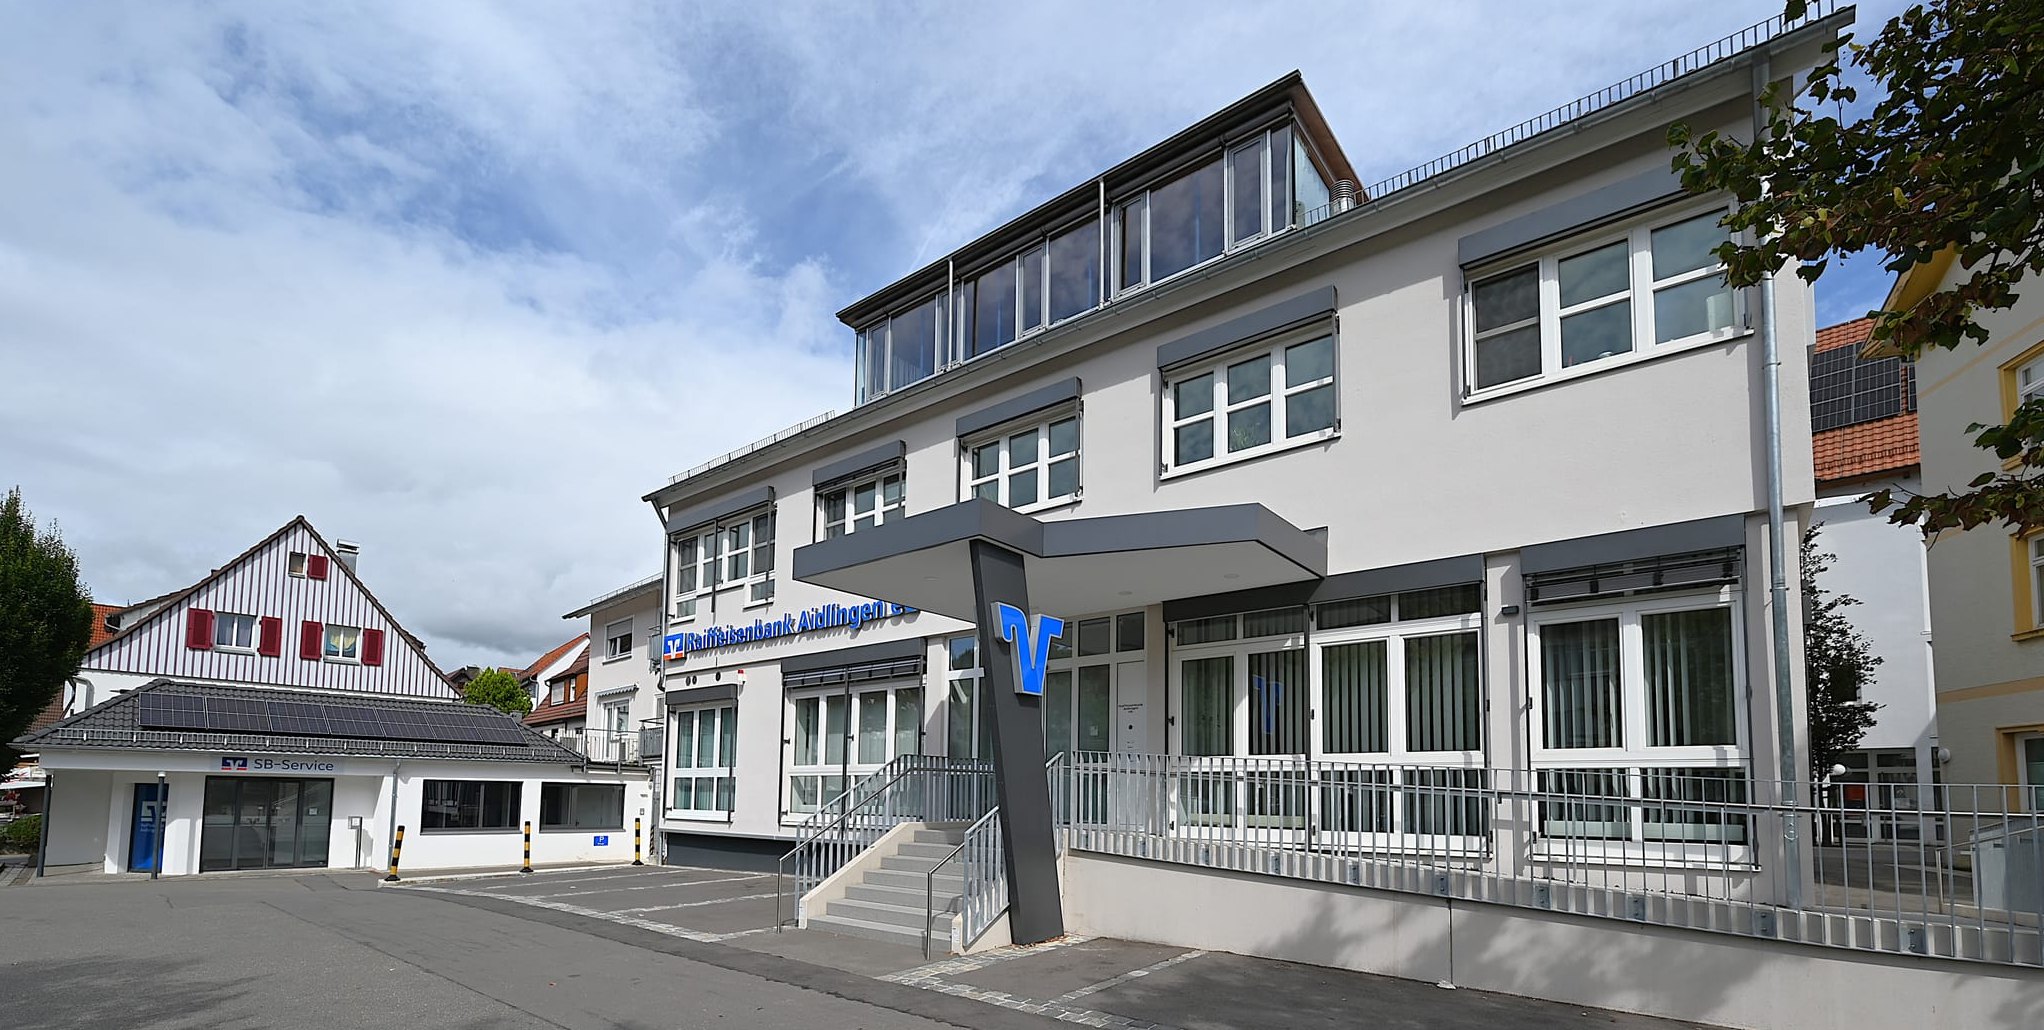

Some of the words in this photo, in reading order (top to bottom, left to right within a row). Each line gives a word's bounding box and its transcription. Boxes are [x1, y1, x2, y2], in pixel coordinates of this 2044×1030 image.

[687, 613, 794, 650] Raiffeisenbank
[797, 599, 885, 629] Aidlingen
[890, 603, 917, 615] e
[254, 758, 335, 772] SB-Service
